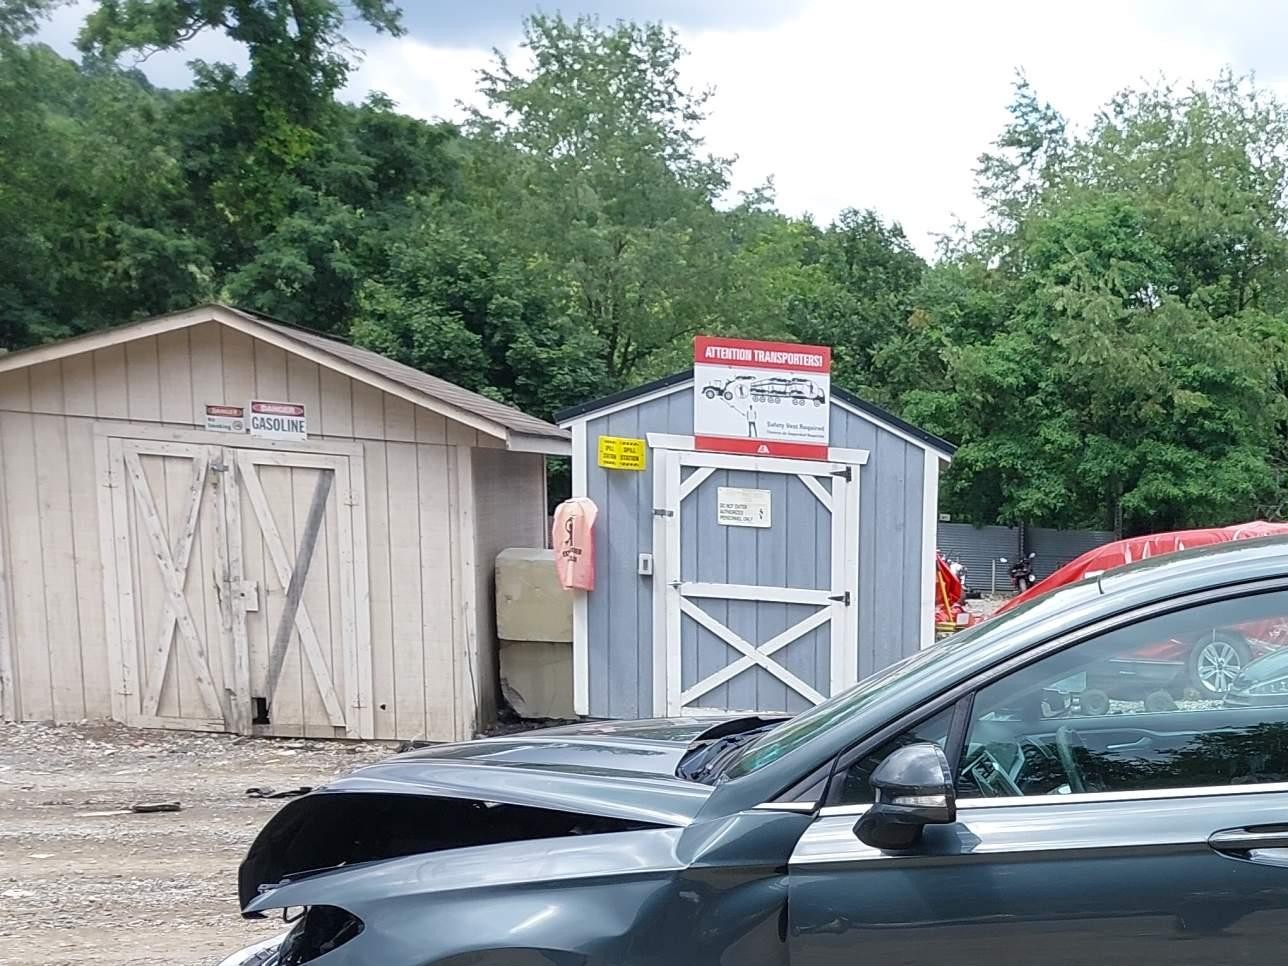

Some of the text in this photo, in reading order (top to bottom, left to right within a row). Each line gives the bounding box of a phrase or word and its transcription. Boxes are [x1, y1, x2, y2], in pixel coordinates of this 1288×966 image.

[705, 346, 823, 366] ATTENTION TRANSPORTERS!
[252, 416, 305, 433] GASOLINE
[767, 421, 784, 429] Safety
[799, 423, 825, 432] Required
